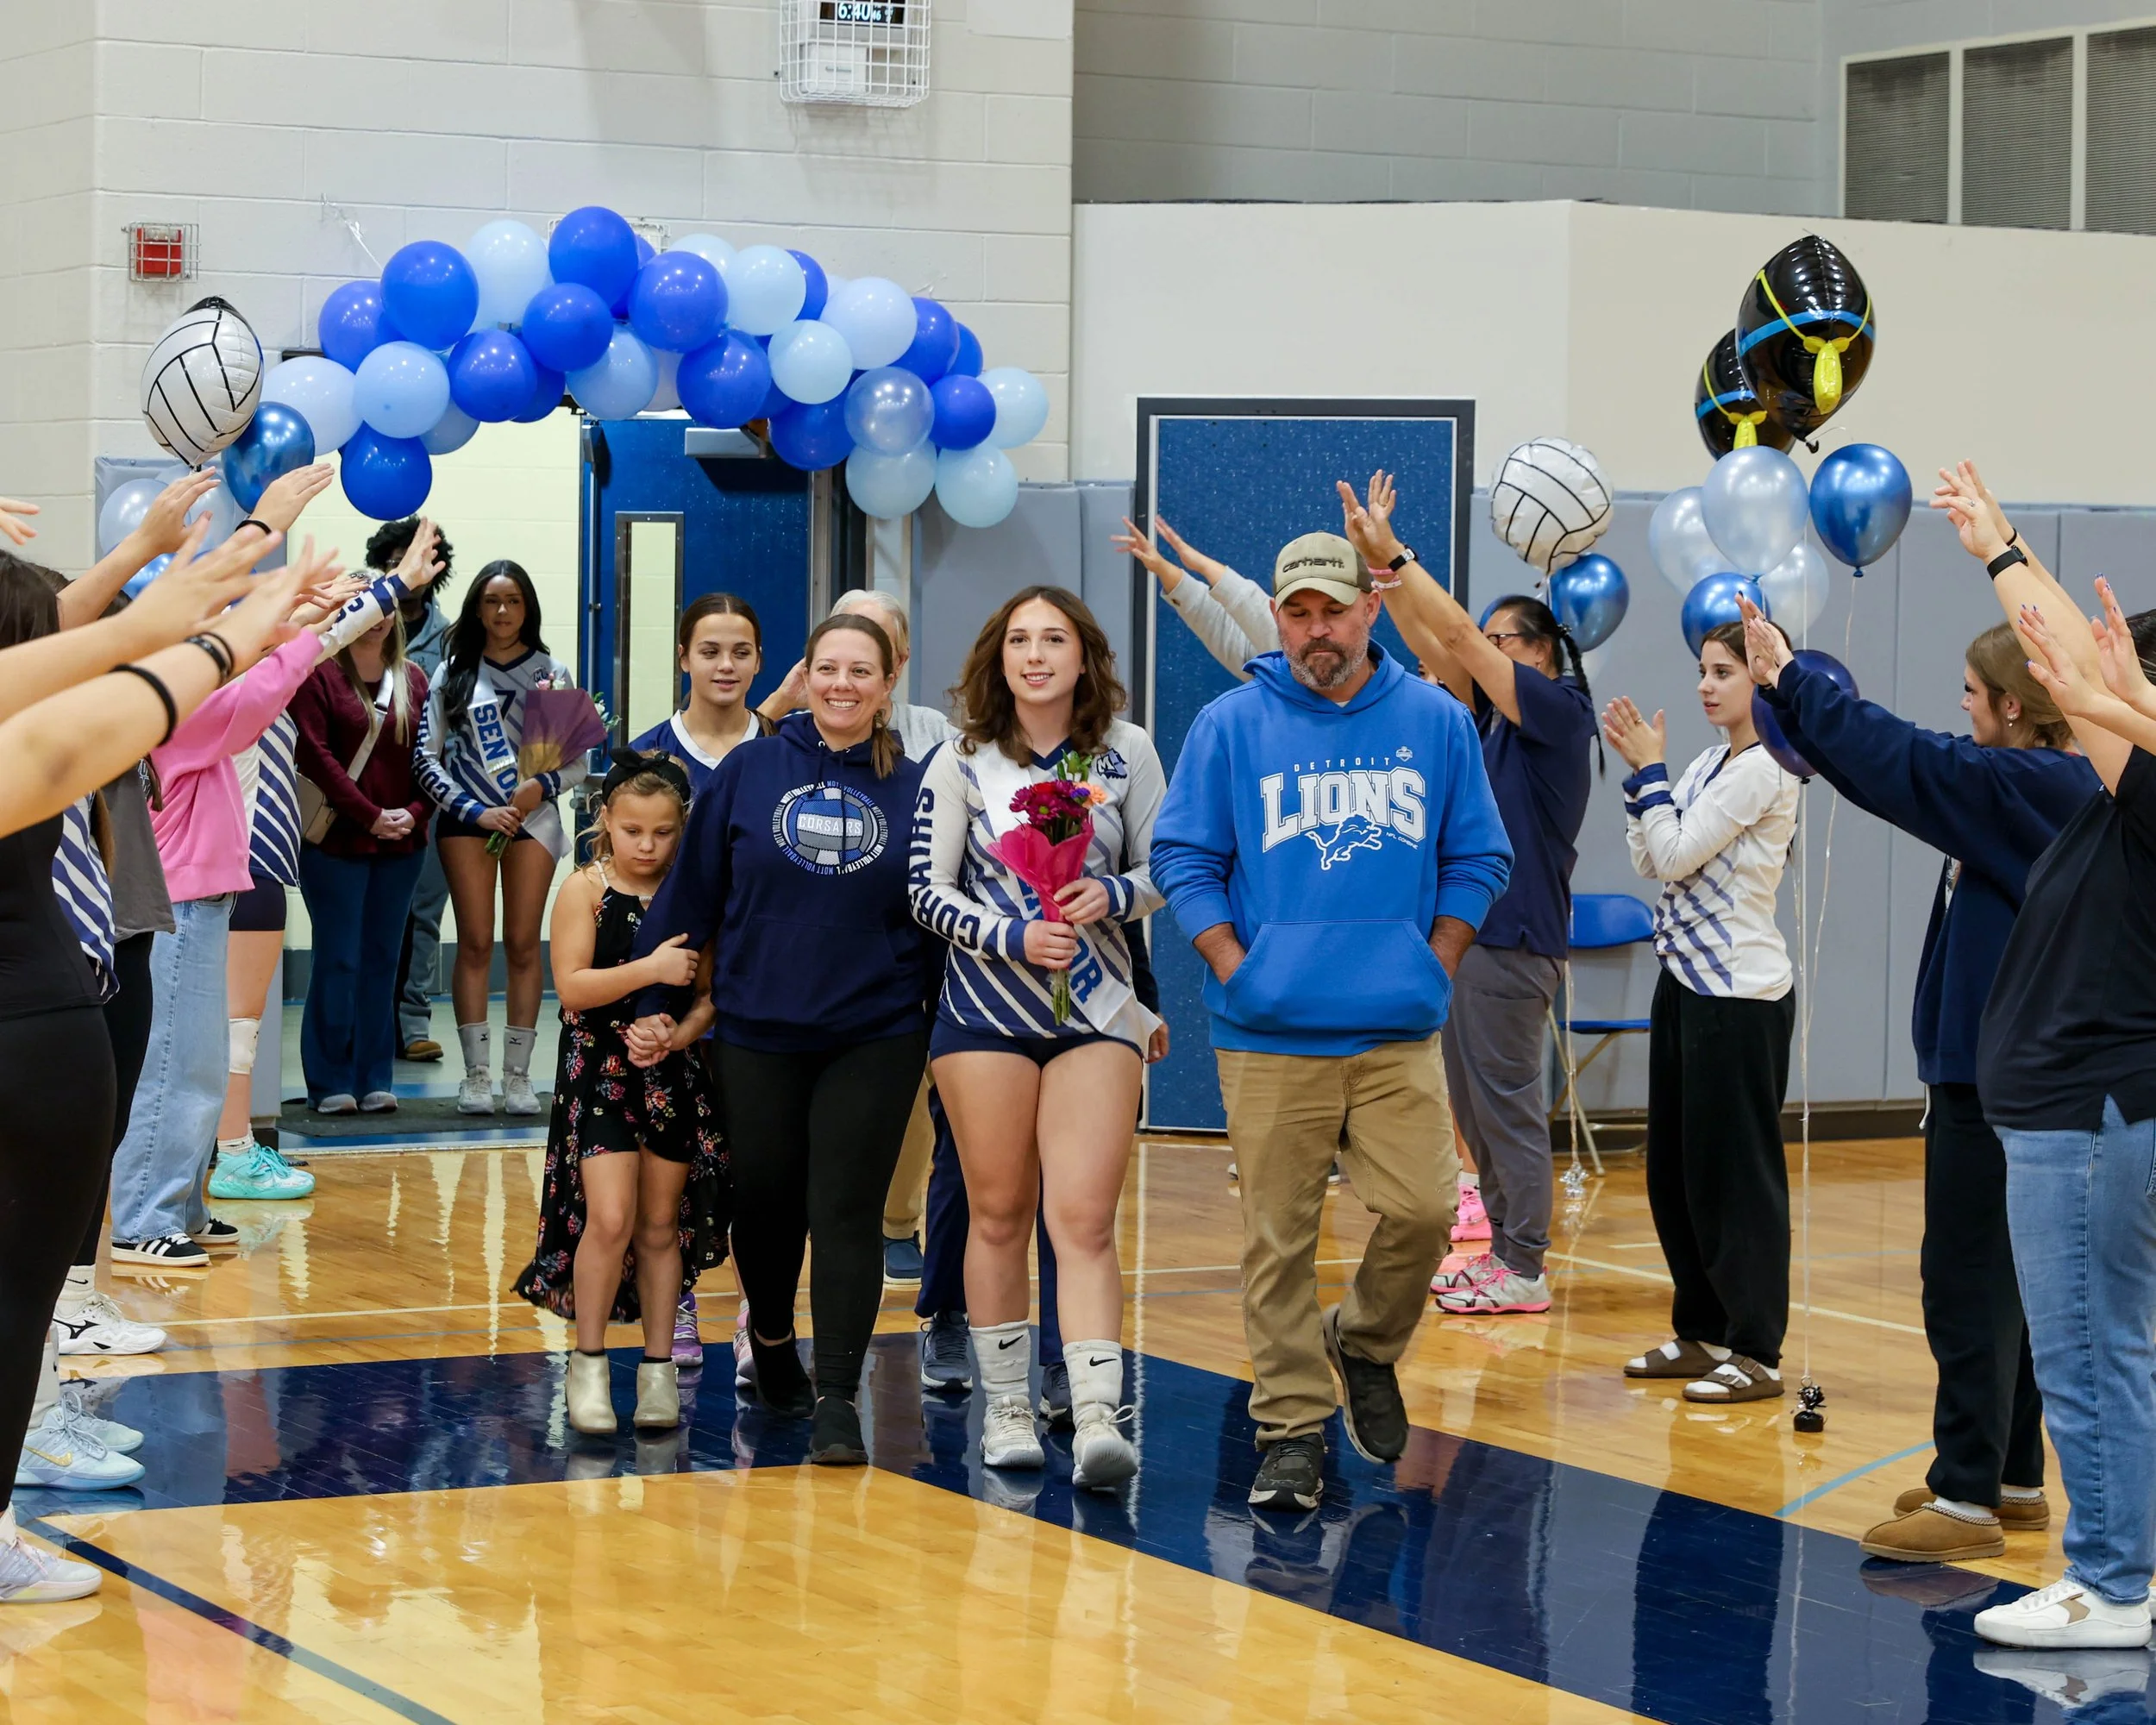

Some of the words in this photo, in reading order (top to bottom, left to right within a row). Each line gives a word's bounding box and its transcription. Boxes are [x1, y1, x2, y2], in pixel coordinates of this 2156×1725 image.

[838, 3, 870, 21] 6:40
[1294, 757, 1390, 772] DETROIT
[843, 786, 874, 806] VOLLEYBALL
[1259, 766, 1426, 853] LIONS
[799, 816, 862, 835] CORSARS
[782, 846, 817, 872] VOLLEYBALL
[816, 867, 834, 875] MOTT
